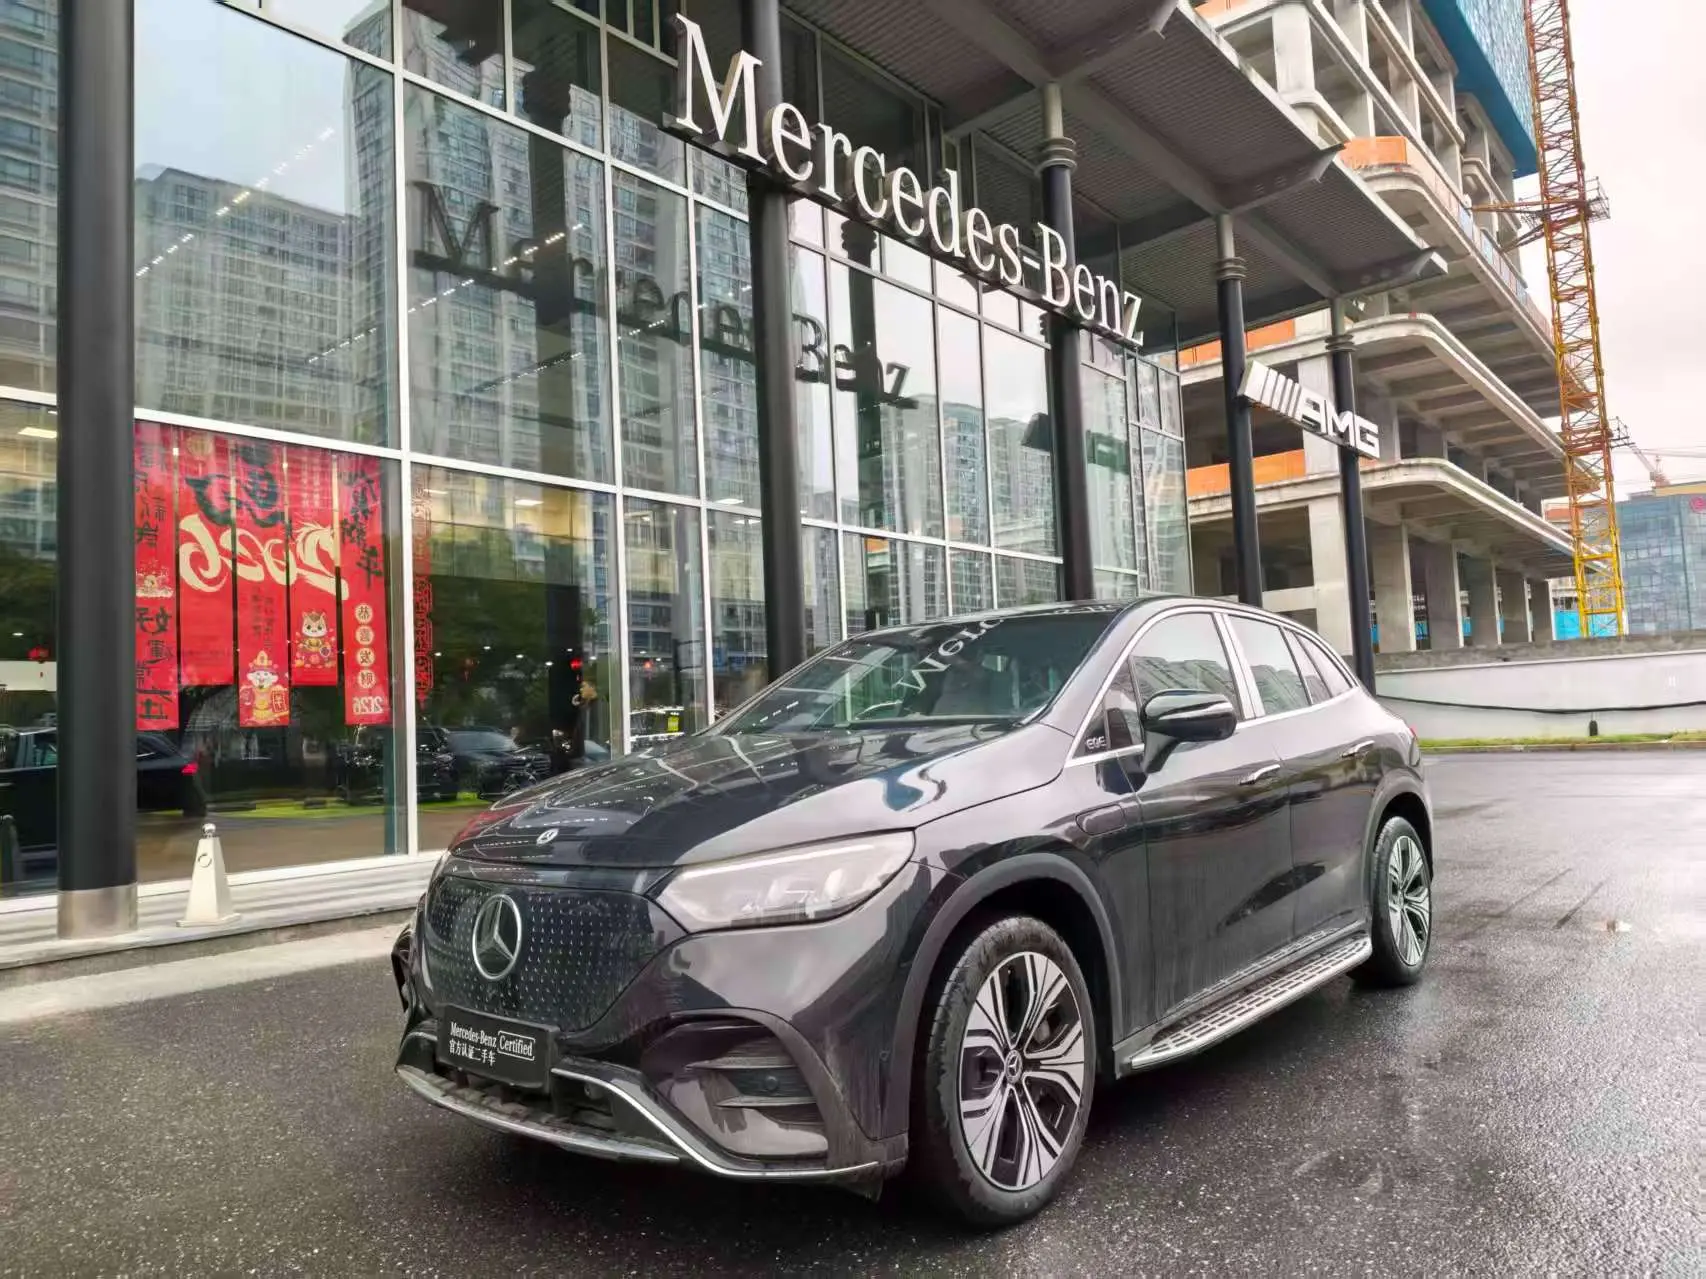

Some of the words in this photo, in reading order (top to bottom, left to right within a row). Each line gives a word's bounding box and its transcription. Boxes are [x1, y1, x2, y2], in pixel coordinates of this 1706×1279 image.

[675, 12, 1144, 347] Mercedes-Benz
[449, 1038, 496, 1067] 官方认证二手车
[450, 1021, 497, 1048] Mercedes-Benz
[499, 1035, 533, 1057] Certified
